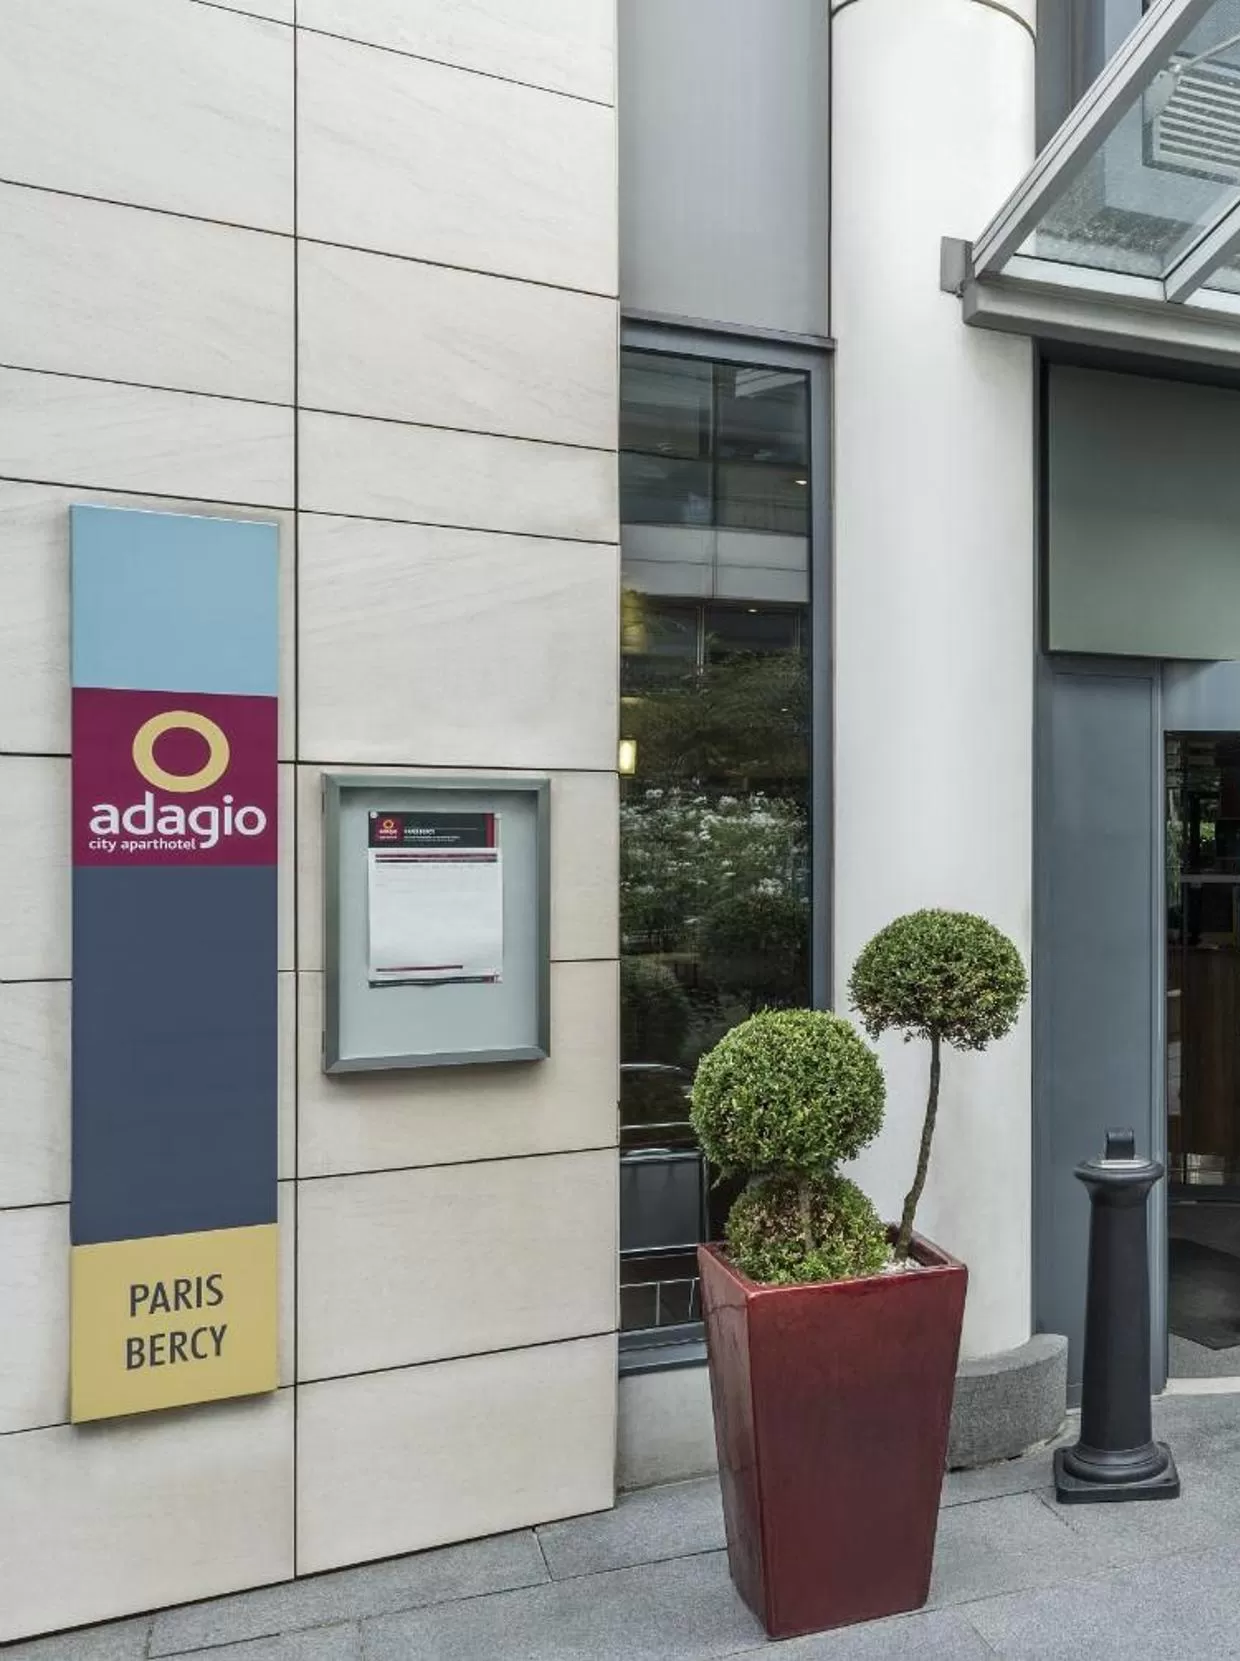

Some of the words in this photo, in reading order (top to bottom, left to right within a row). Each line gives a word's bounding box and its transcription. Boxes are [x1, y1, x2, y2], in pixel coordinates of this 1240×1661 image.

[89, 790, 267, 849] adagio
[88, 837, 117, 851] city
[120, 838, 196, 852] aparthotel
[130, 1274, 224, 1317] PARIS
[126, 1324, 228, 1370] BERCY
